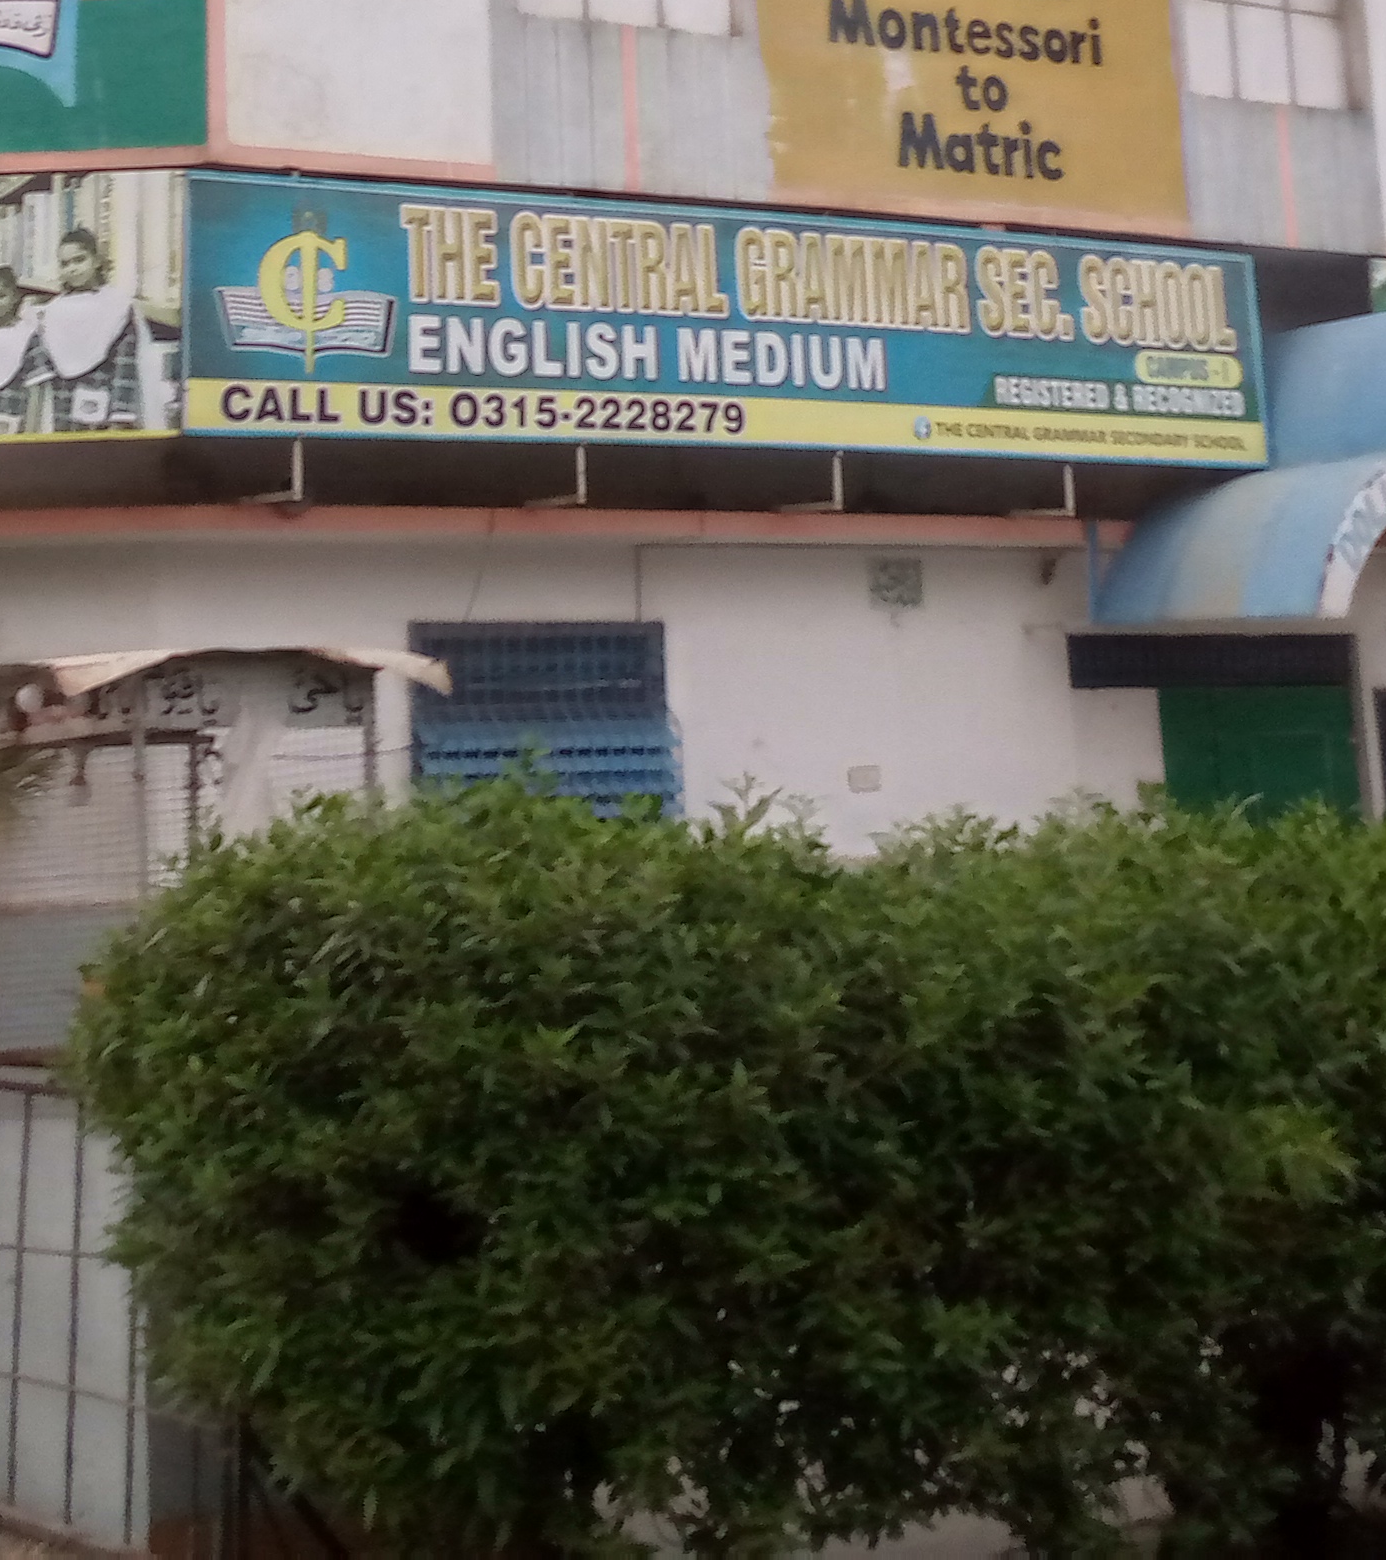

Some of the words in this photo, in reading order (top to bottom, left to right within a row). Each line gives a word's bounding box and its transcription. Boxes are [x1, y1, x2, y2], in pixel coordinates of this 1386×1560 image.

[956, 65, 1008, 111] to
[898, 111, 1065, 179] Matric
[399, 204, 500, 307] THE
[509, 210, 730, 320] CENTRAL
[735, 227, 971, 334] GRAMMAR
[976, 244, 1075, 340] SEC.
[1079, 254, 1238, 353] SCHOOL
[408, 314, 659, 381] ENGLISH
[677, 327, 888, 391] MEDIUM
[220, 384, 342, 424] CALL
[359, 388, 435, 427] US:
[449, 392, 745, 434] 0315-2228279
[994, 374, 1111, 411] REGISTERED
[1113, 381, 1131, 413] &
